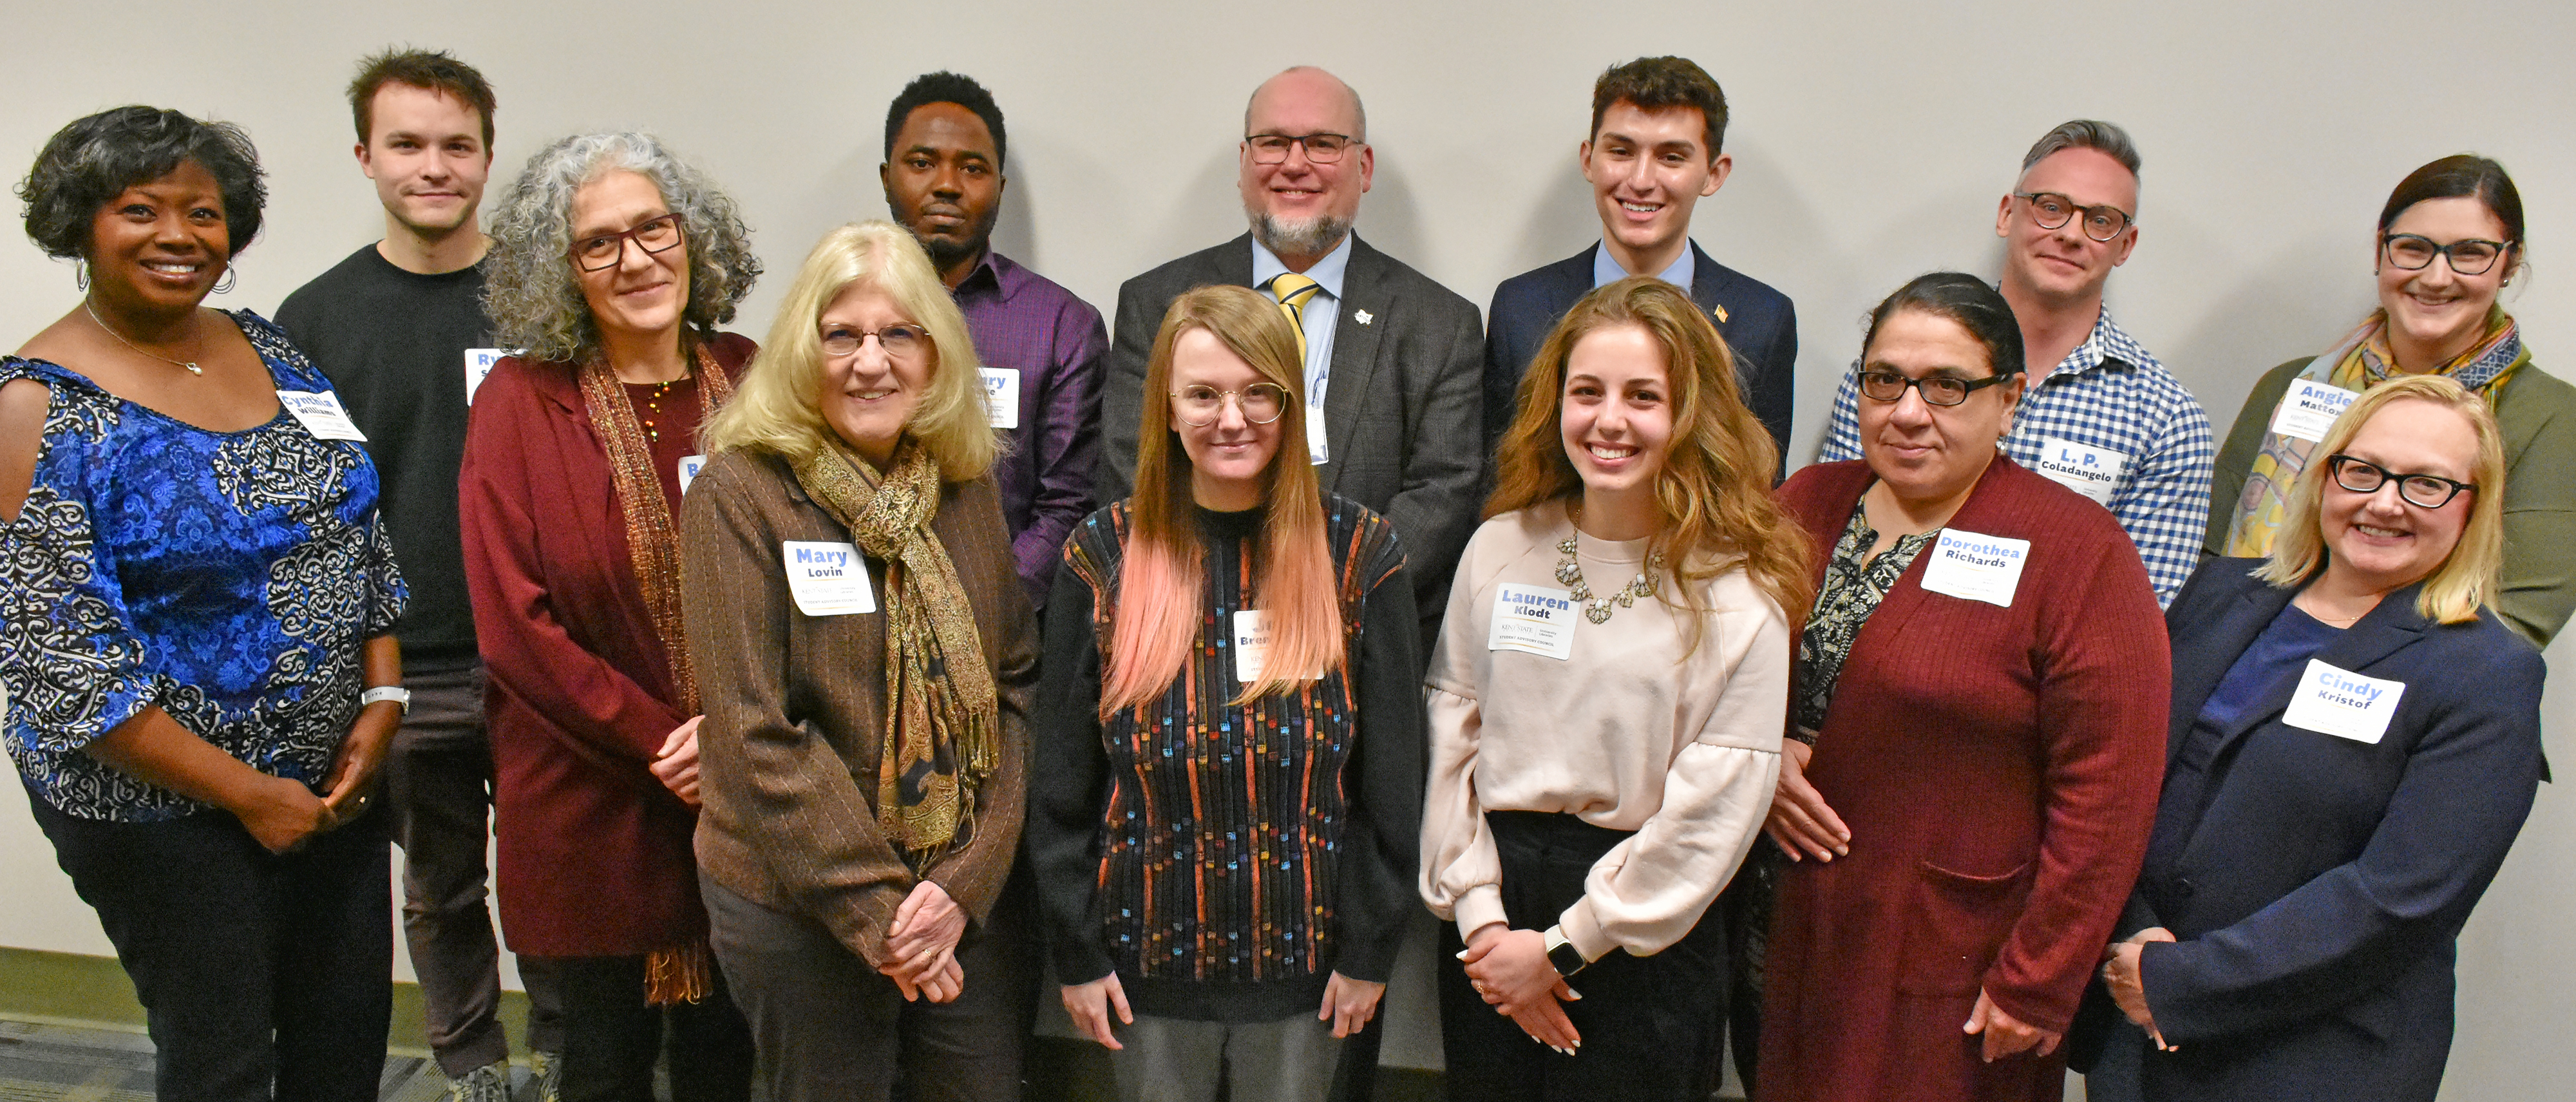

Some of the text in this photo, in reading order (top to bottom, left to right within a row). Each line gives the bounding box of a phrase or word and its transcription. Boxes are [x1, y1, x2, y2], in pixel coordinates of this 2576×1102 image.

[281, 395, 334, 408] Cynthia
[2300, 386, 2351, 406] Angie
[298, 406, 336, 416] Williams
[2061, 448, 2099, 468] L. P.
[2041, 461, 2111, 482] Coladangelo
[1940, 537, 2020, 558] Dorothea
[796, 548, 847, 567] Mary
[1946, 549, 2006, 567] Richards
[808, 566, 842, 577] Lovin
[1502, 589, 1569, 611] Lauren
[1515, 605, 1550, 619] Klodt
[2319, 672, 2383, 701] Cindy
[2318, 690, 2372, 709] Kristof
